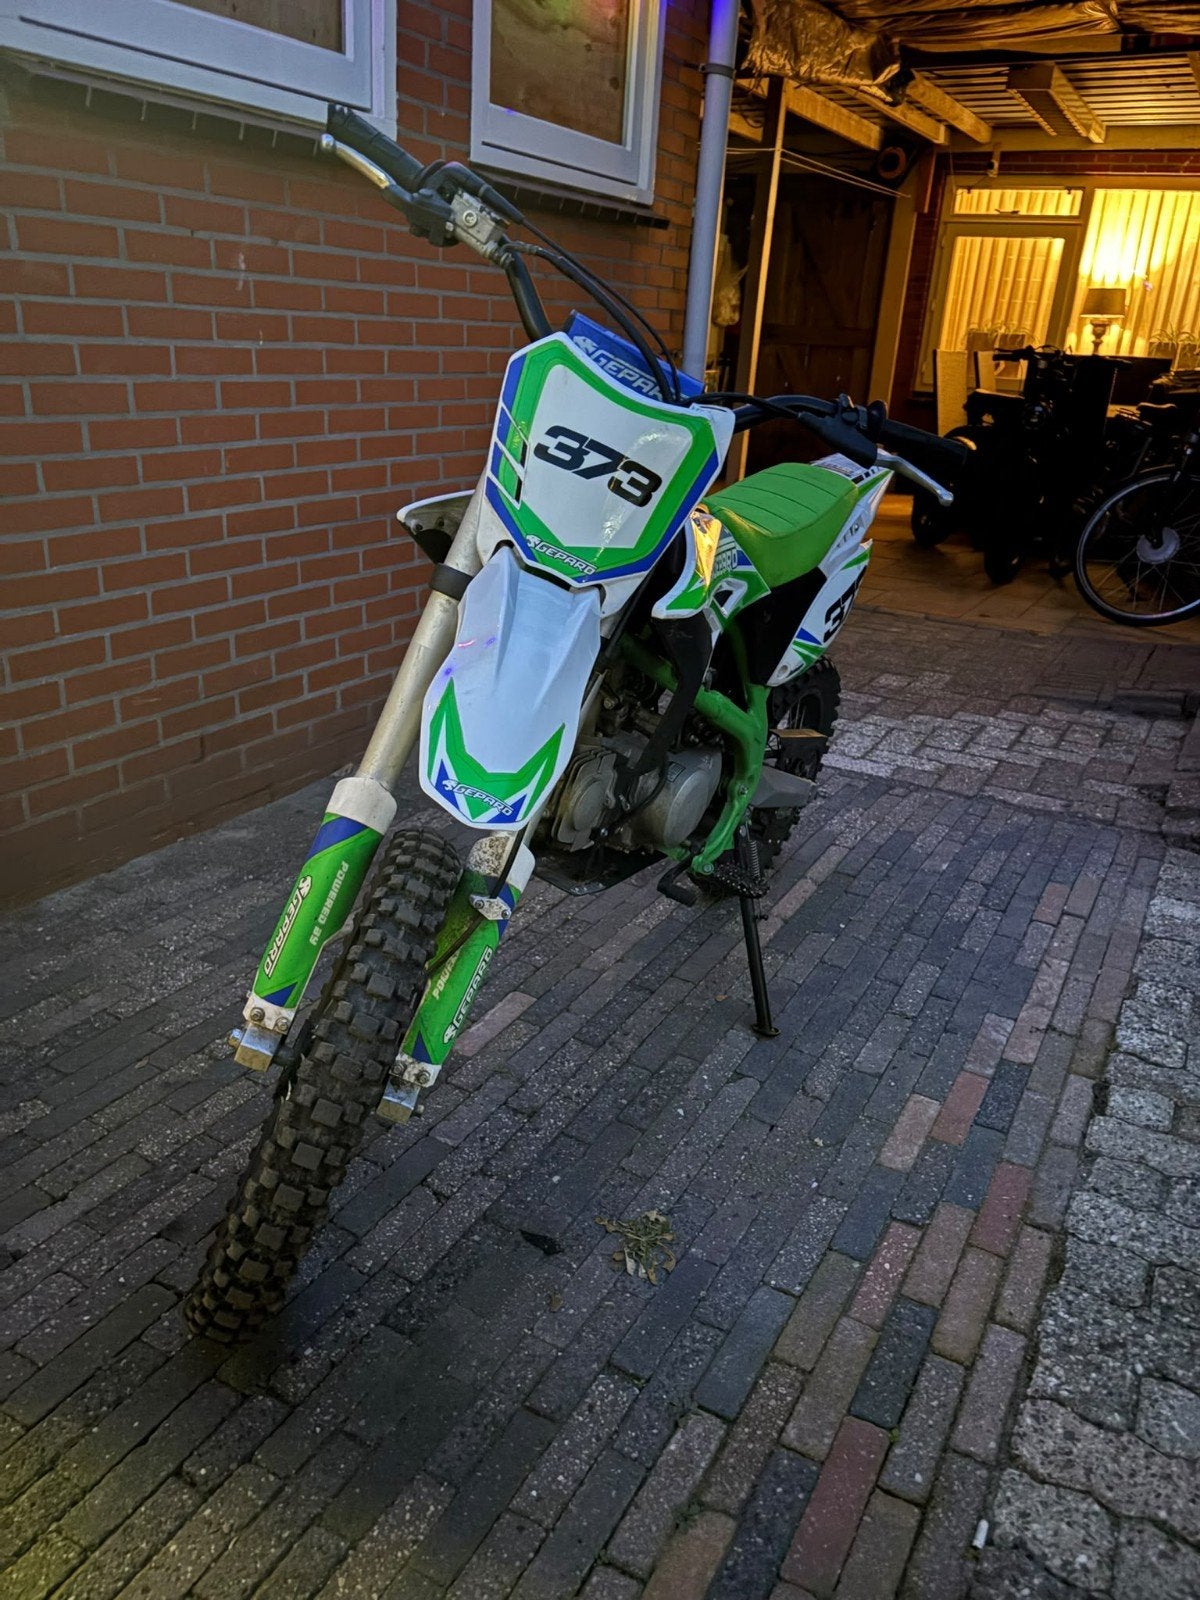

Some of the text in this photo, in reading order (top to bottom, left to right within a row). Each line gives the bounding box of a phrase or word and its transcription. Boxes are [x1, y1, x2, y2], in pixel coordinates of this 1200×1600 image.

[534, 425, 663, 507] 373
[536, 539, 598, 576] GEPARD
[823, 565, 867, 643] 37
[453, 783, 515, 817] GEPARD
[263, 886, 302, 979] GEPARD
[309, 860, 349, 946] POWERED BY
[453, 945, 493, 1028] GEPARD
